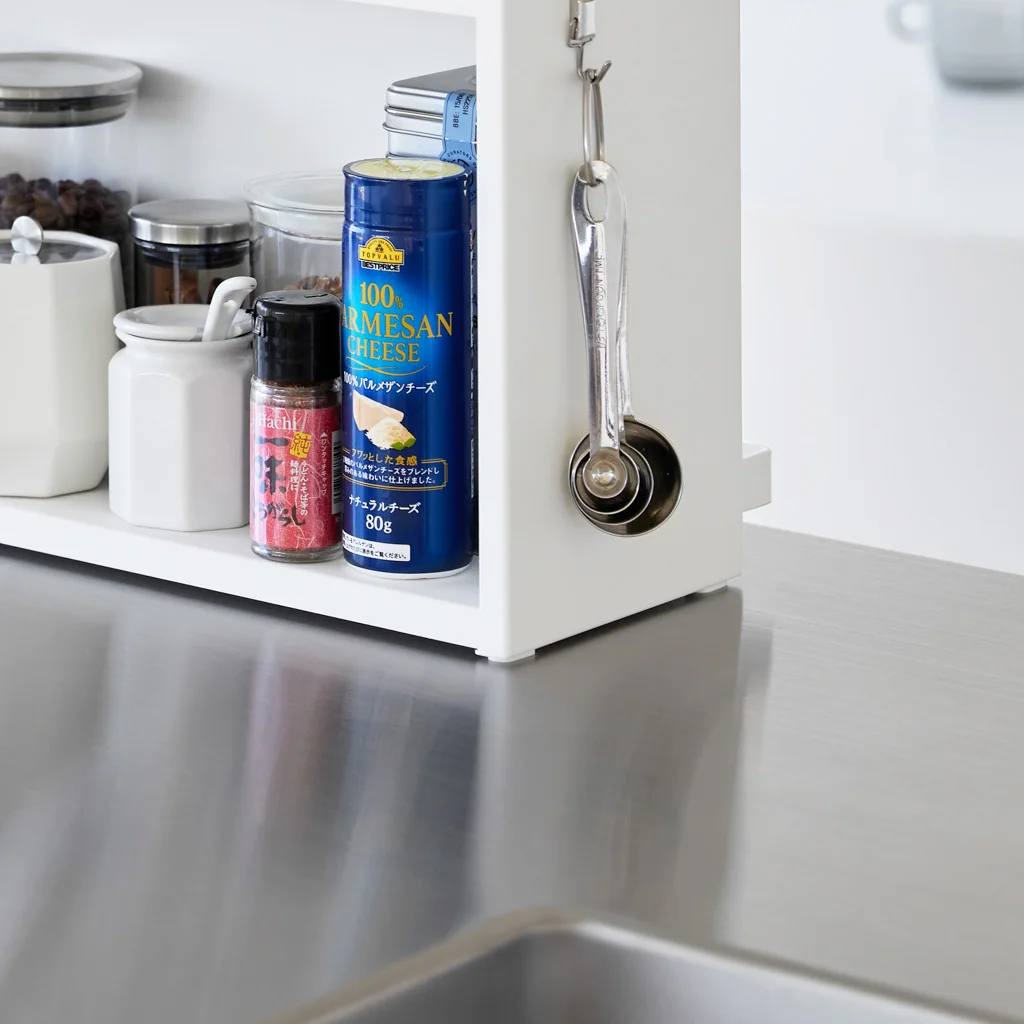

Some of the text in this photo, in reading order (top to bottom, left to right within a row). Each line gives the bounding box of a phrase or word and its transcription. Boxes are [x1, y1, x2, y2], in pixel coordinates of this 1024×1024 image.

[362, 251, 400, 261] TOPVALU
[360, 280, 403, 309] 100%
[342, 304, 453, 339] ARMESAN
[347, 334, 420, 363] CHEESE
[349, 495, 421, 514] ナチュラルチーズ
[366, 514, 392, 533] 80g
